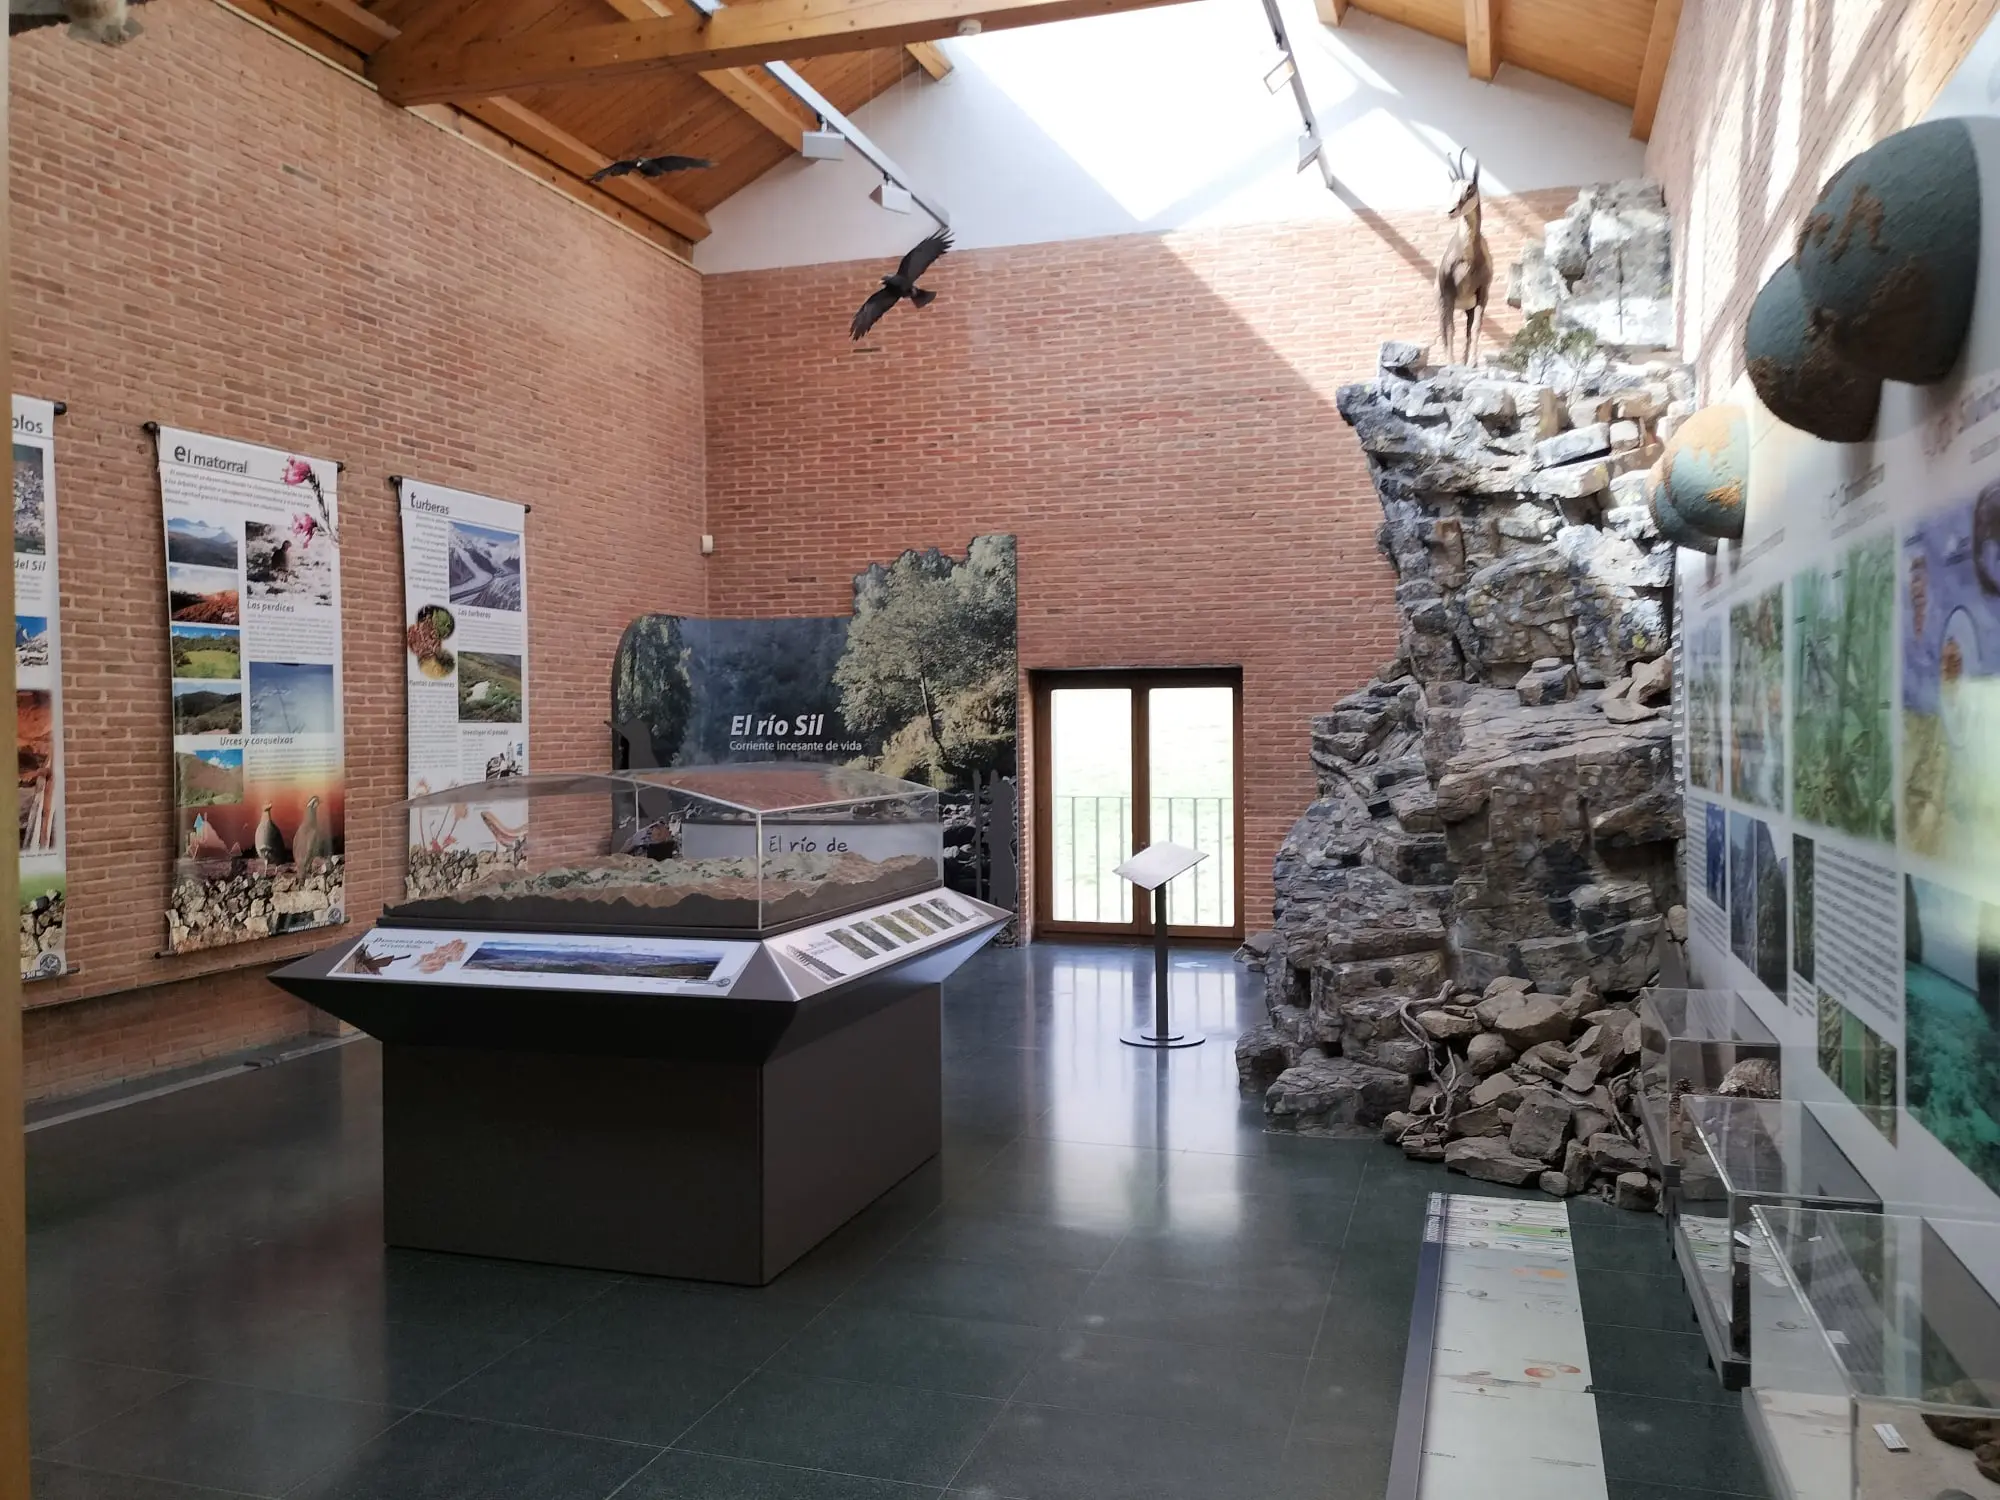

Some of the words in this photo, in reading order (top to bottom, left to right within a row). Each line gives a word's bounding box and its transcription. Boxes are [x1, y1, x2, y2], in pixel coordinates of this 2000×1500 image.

[193, 453, 248, 474] matorral
[410, 491, 450, 515] turberas
[31, 559, 47, 572] Sil
[247, 600, 260, 610] Las
[261, 602, 294, 613] perdices
[730, 714, 752, 736] El
[756, 714, 789, 736] río
[794, 713, 825, 736] Sil
[220, 737, 243, 746] Urces
[244, 738, 249, 747] y
[250, 736, 293, 746] carqueixas
[729, 740, 775, 751] Corriente
[776, 740, 824, 751] incesante
[825, 740, 838, 751] de
[840, 740, 862, 751] vida
[769, 834, 782, 853] El
[790, 836, 817, 852] río
[826, 837, 848, 852] de
